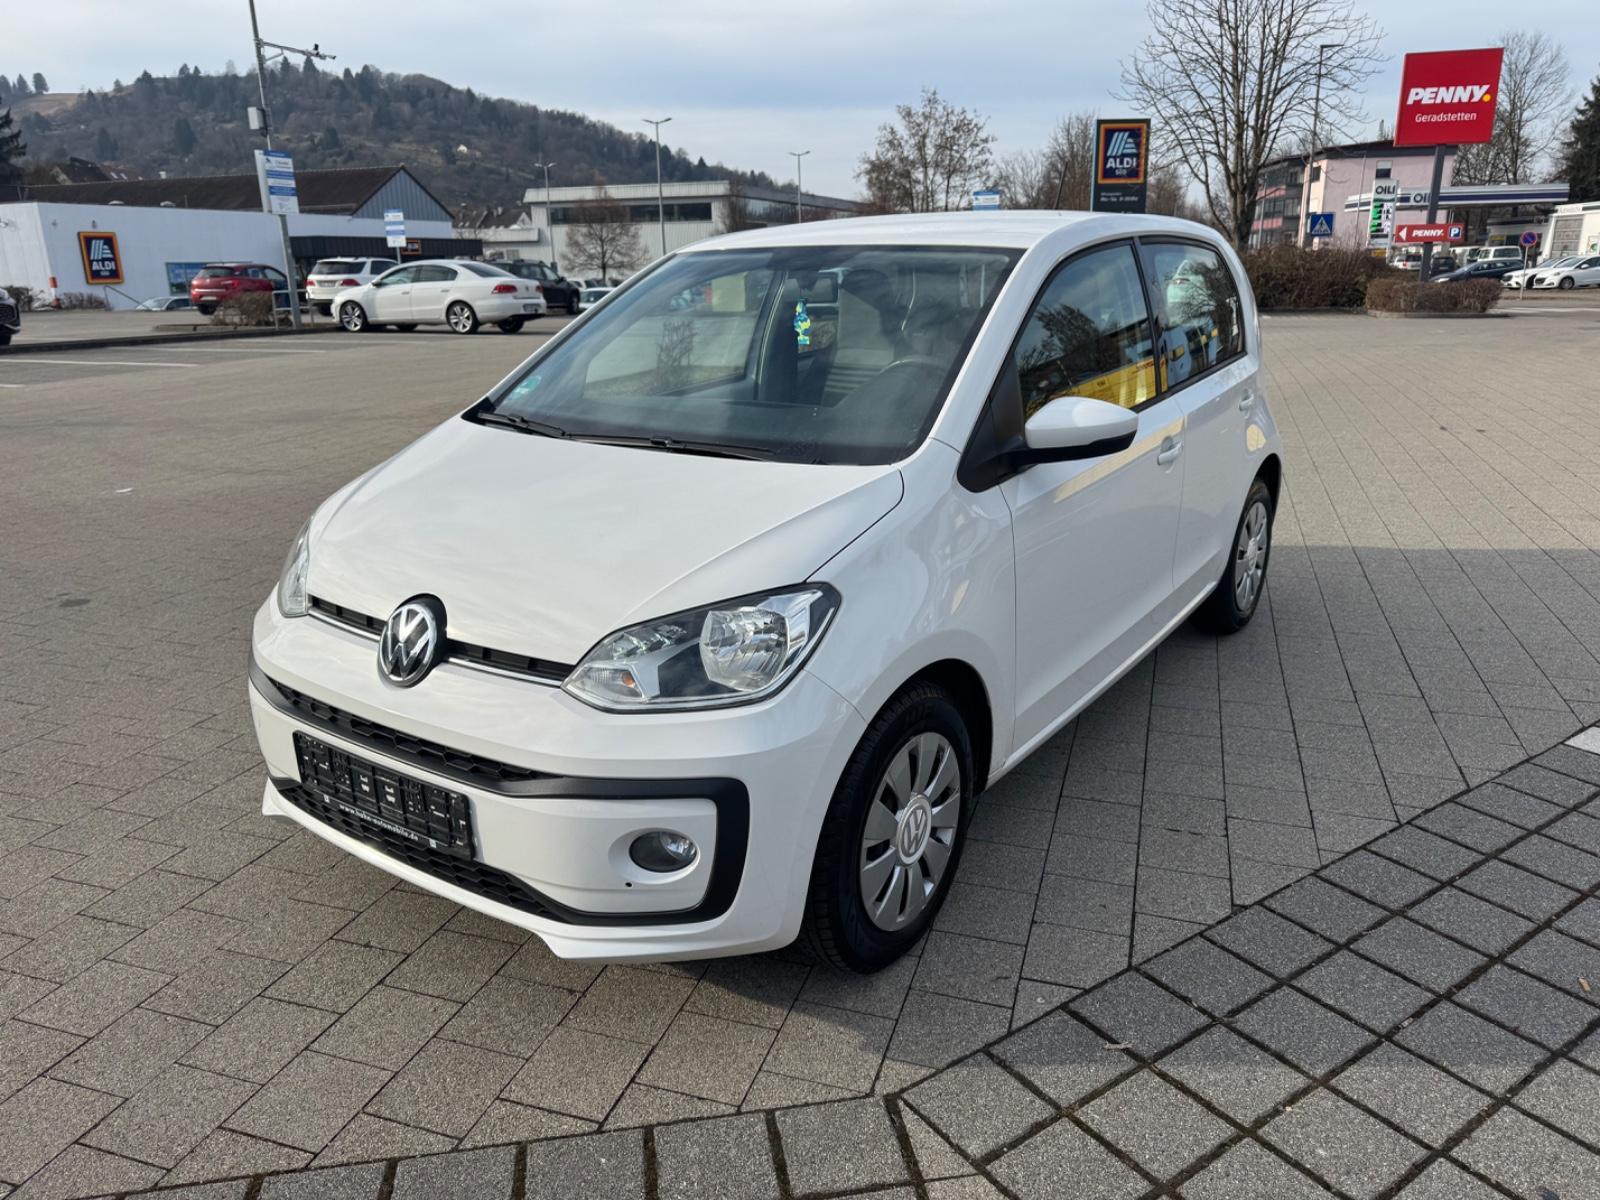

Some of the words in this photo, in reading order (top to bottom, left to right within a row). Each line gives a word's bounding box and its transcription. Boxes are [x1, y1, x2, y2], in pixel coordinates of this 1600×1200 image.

[1415, 111, 1477, 123] Geradstetten
[1106, 157, 1137, 169] ALDI
[92, 261, 116, 270] ALDI
